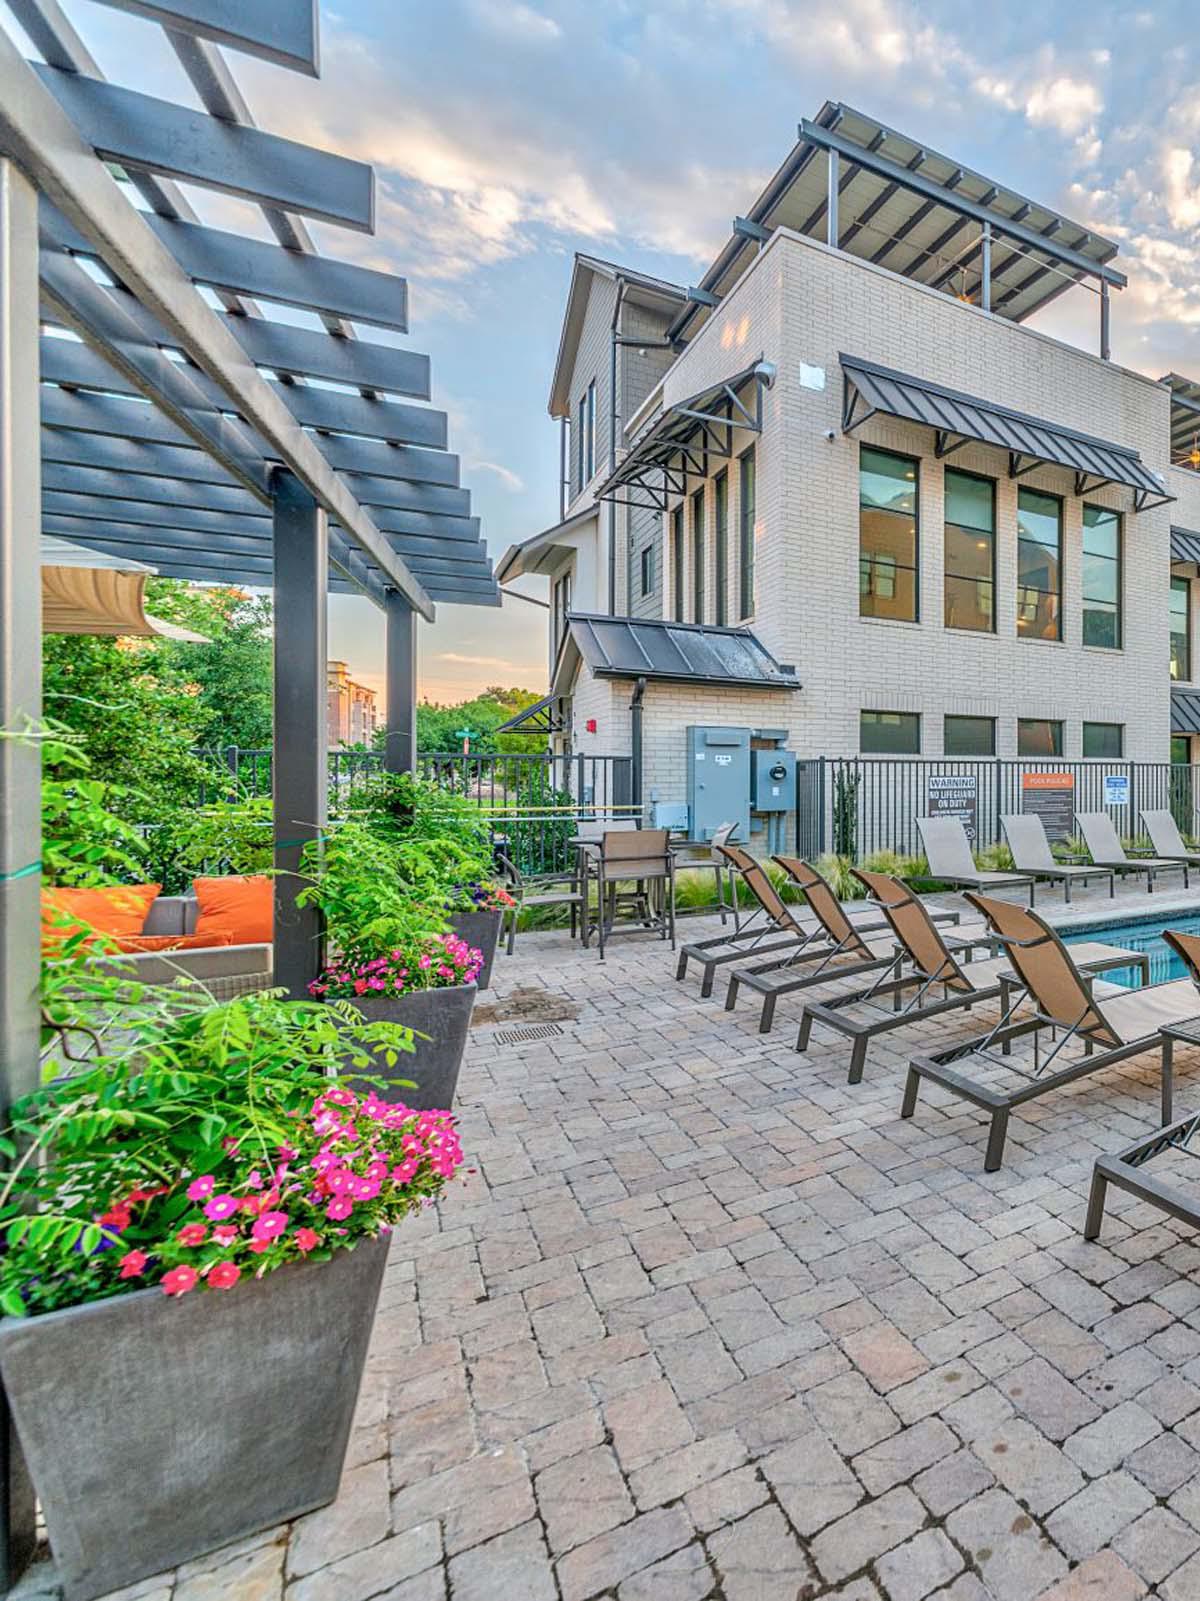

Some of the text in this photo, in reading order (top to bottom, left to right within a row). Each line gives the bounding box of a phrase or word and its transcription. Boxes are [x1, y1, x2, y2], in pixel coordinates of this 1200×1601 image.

[930, 778, 975, 787] WARNING
[930, 790, 975, 799] NO LIFEGUARD
[938, 799, 967, 808] ON DUTY
